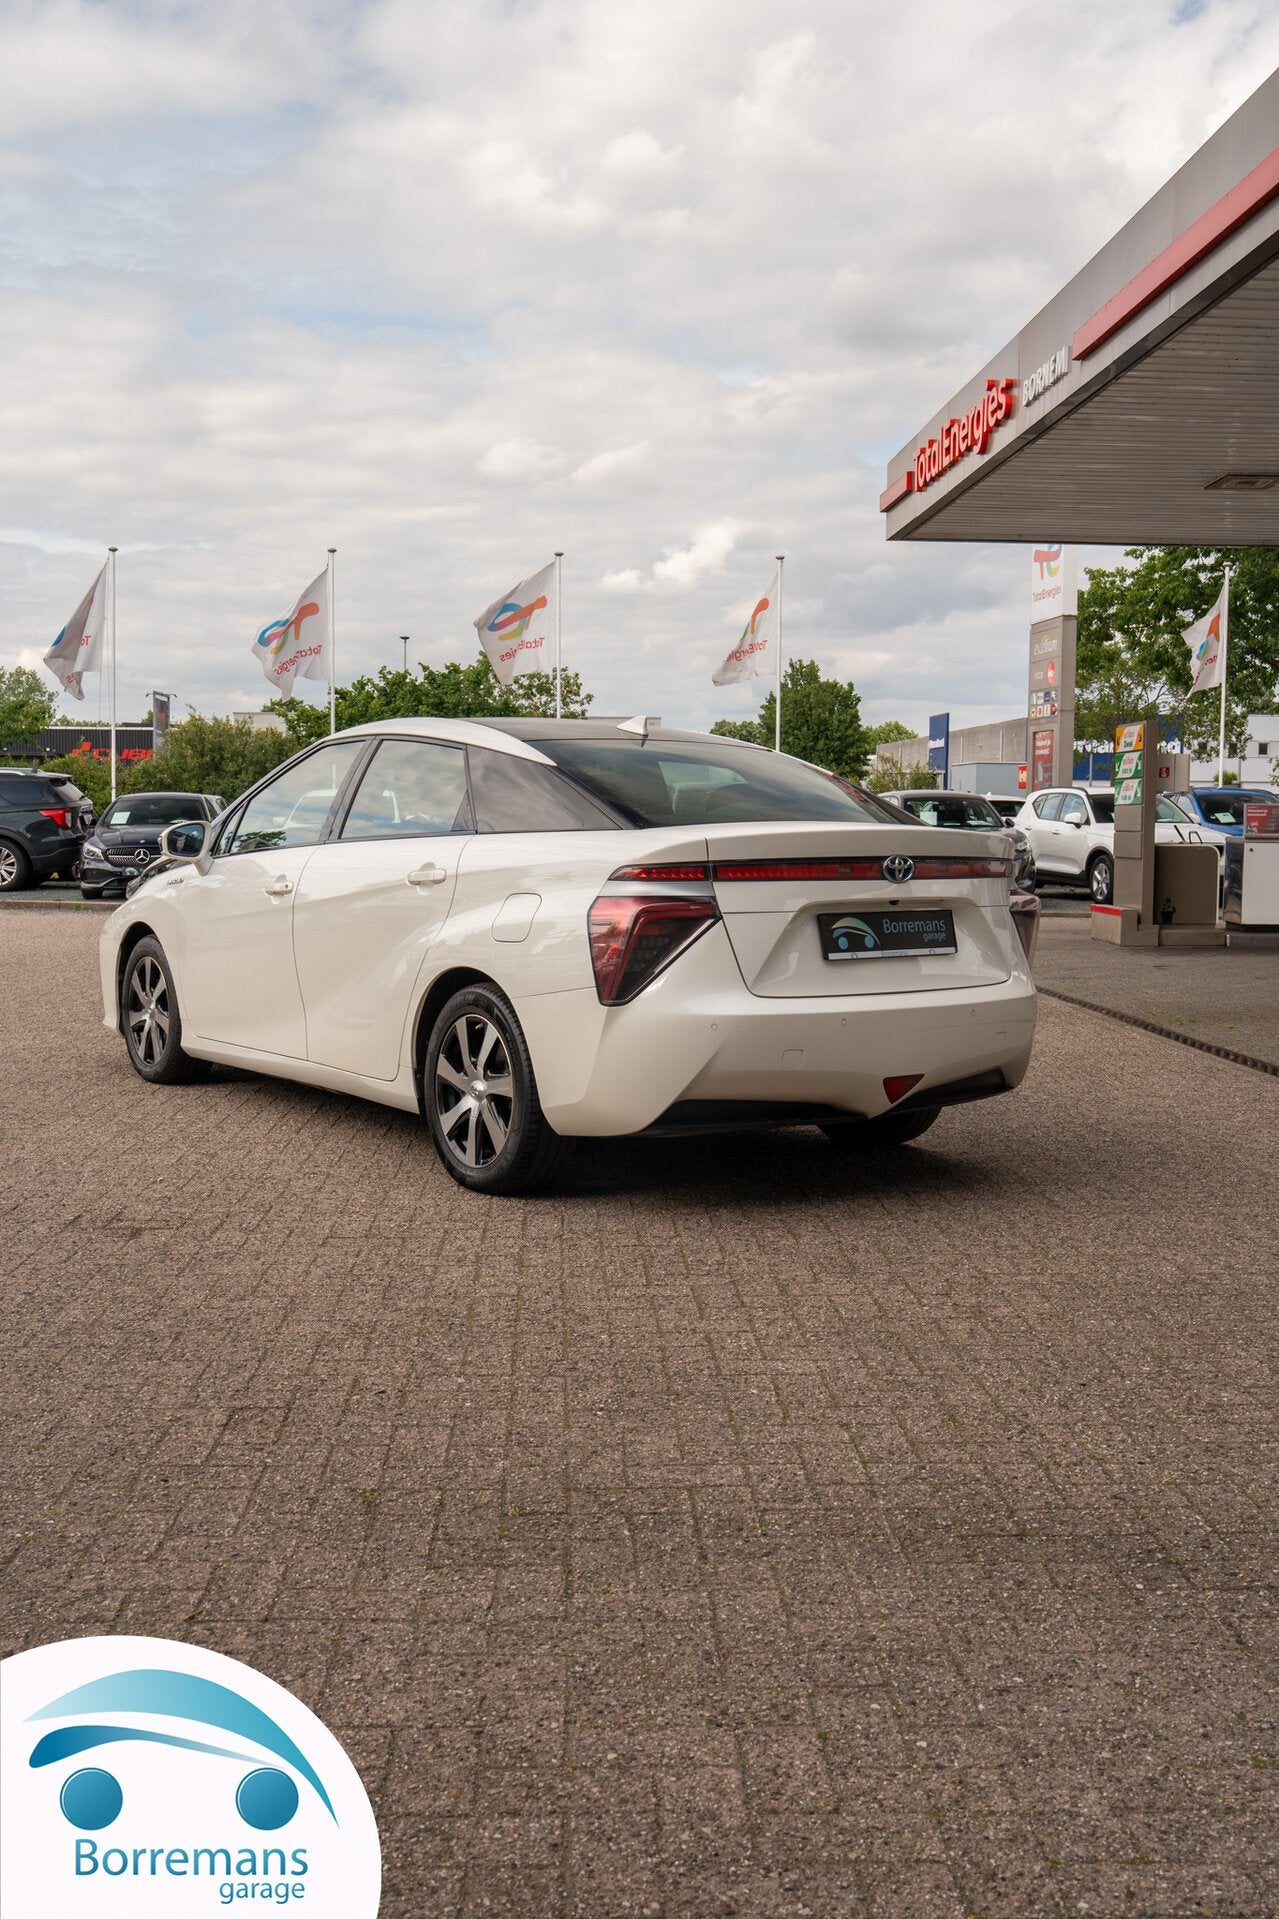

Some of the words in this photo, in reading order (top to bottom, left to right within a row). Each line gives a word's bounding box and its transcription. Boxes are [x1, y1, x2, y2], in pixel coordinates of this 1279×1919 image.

[914, 379, 1013, 491] TotalEnergies
[883, 919, 946, 934] Borremans
[923, 932, 946, 942] garage
